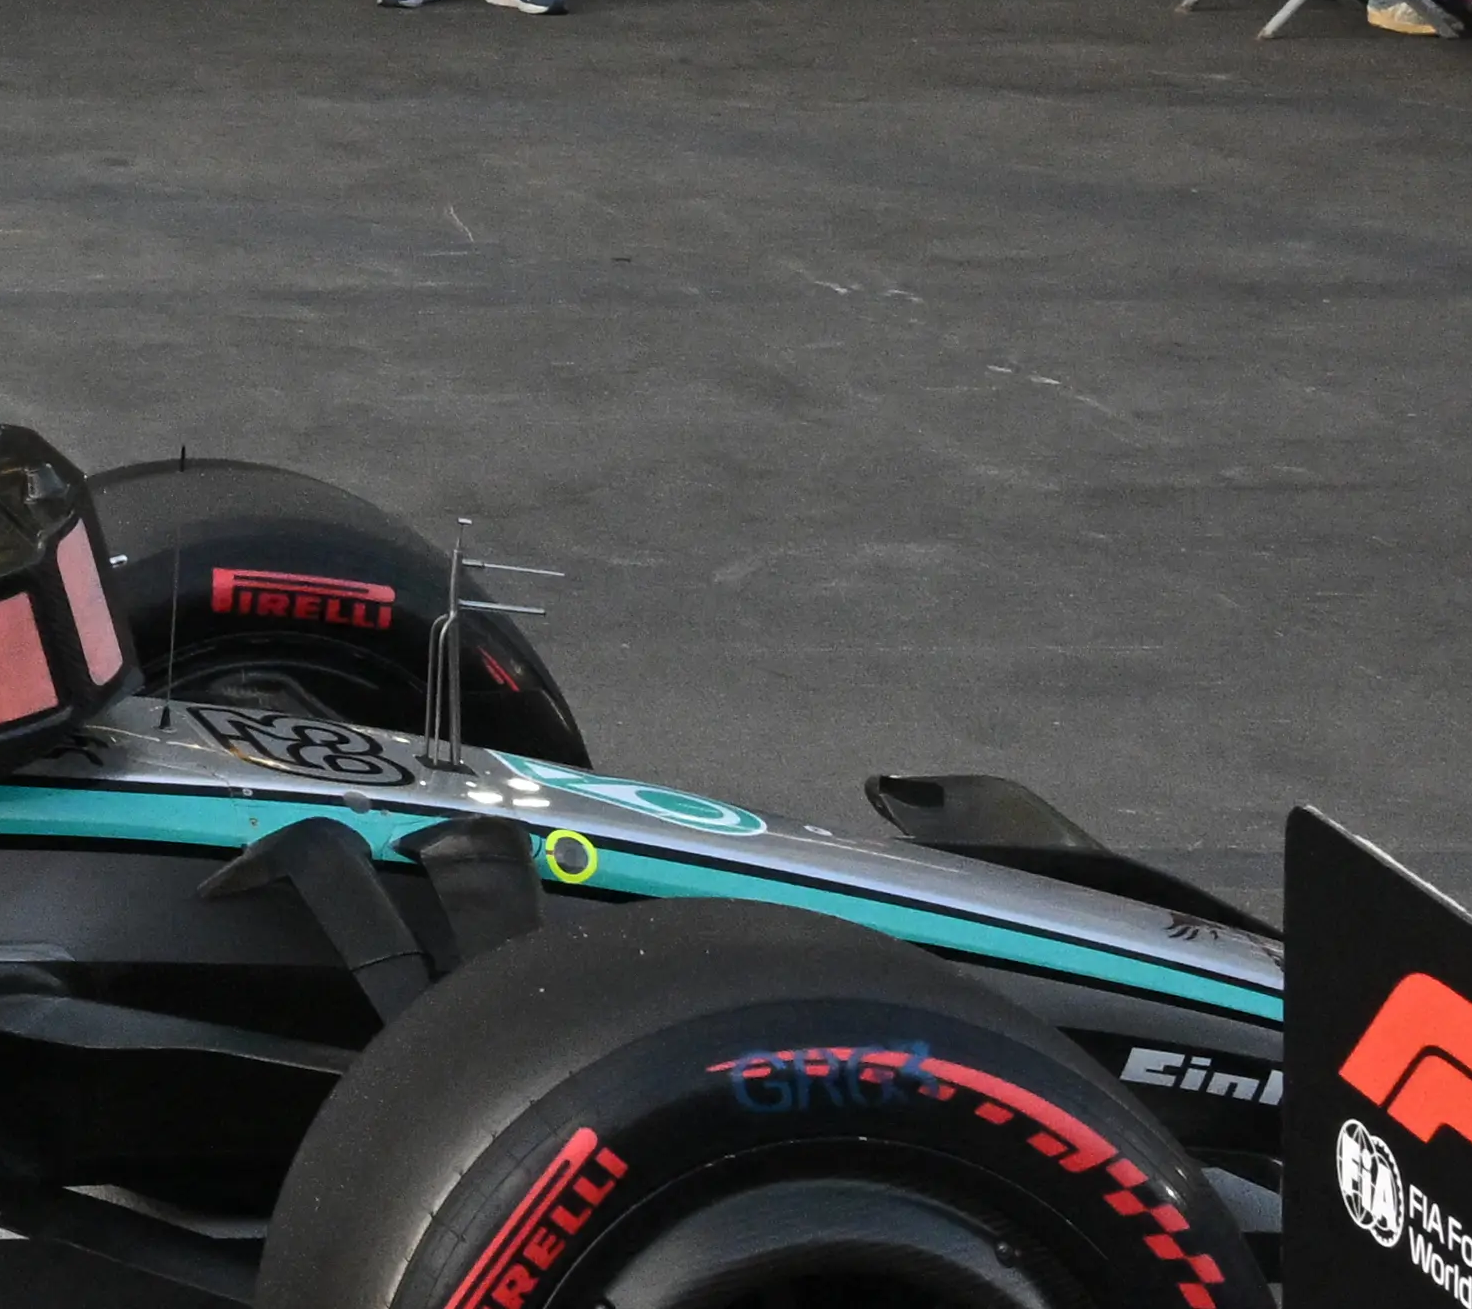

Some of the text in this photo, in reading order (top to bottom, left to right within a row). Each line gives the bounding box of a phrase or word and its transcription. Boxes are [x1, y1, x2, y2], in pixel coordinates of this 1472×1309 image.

[212, 568, 396, 629] PIRELLI
[1409, 1184, 1447, 1244] FIA
[1409, 1227, 1472, 1305] World
